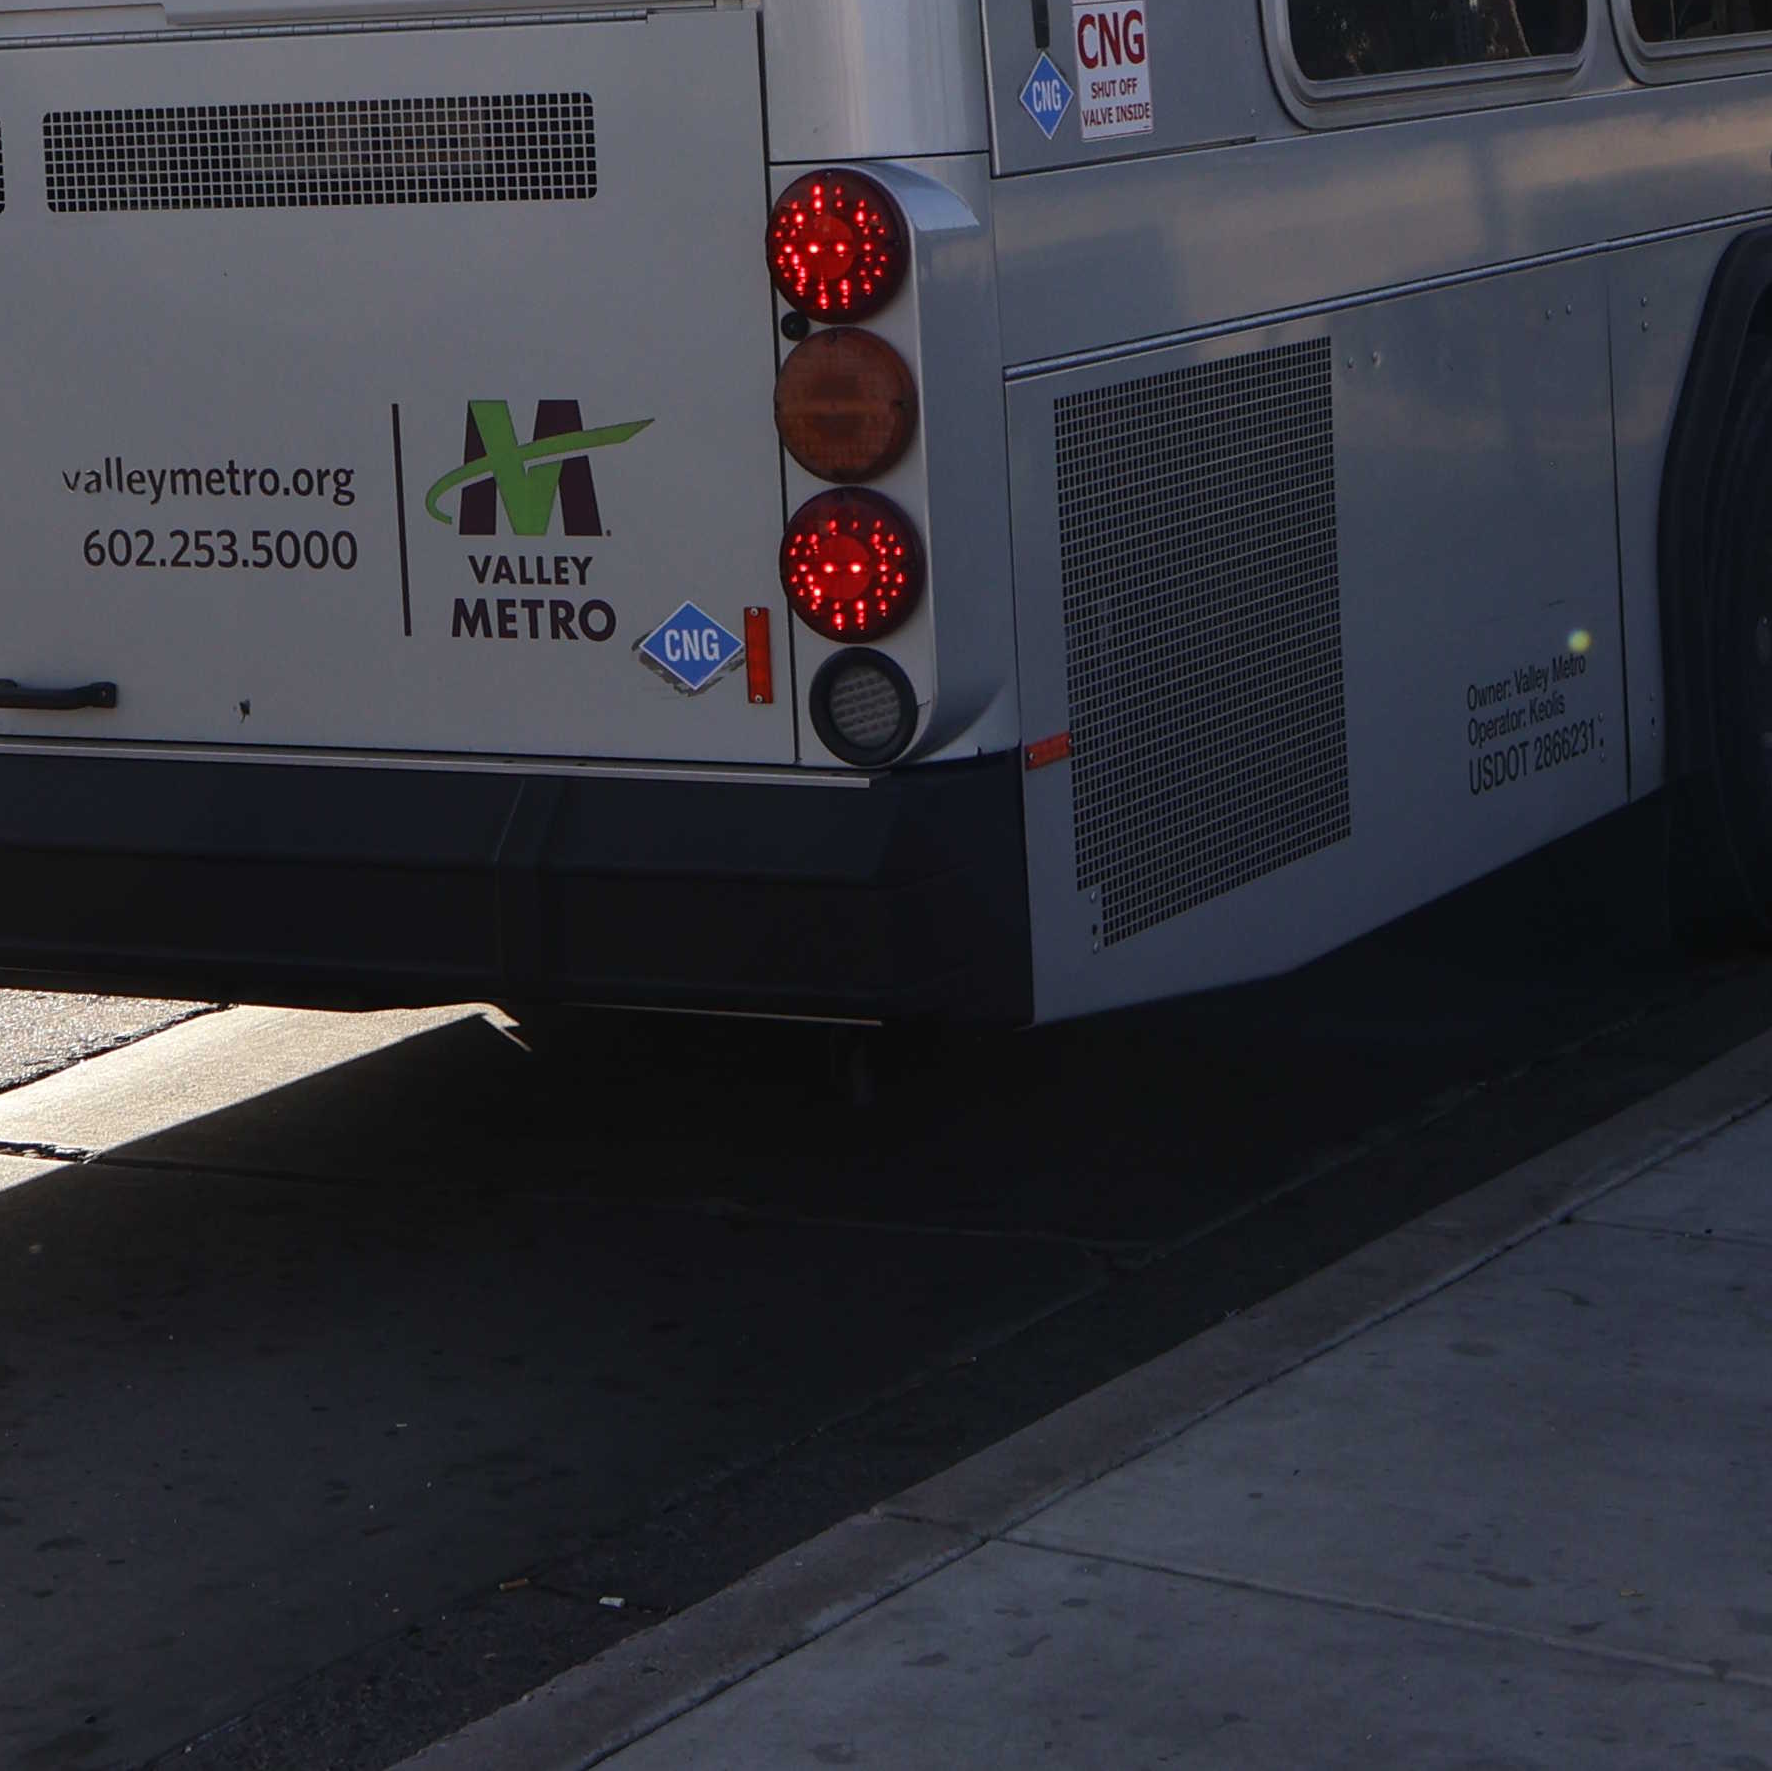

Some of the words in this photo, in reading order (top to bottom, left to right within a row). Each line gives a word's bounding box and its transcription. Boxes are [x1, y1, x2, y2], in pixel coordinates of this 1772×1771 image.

[1076, 9, 1146, 70] CNG
[1031, 79, 1062, 113] CNG
[1090, 79, 1118, 100] SHUT
[1118, 77, 1138, 96] OFF
[1082, 105, 1114, 127] VALVE
[1115, 101, 1151, 124] INSIDE
[62, 457, 357, 506] valleymetro.org
[82, 529, 359, 572] 602.253.5000
[468, 555, 594, 587] VALLEY
[451, 597, 618, 642] METRO
[663, 628, 720, 663] CNG
[1467, 682, 1512, 709] Owner:
[1514, 664, 1549, 694] Valley
[1552, 652, 1586, 681] Metro
[1467, 708, 1528, 749] Operator:
[1529, 690, 1566, 722] Keolis
[1468, 741, 1529, 796] USDOT
[1533, 718, 1596, 772] 2866231
